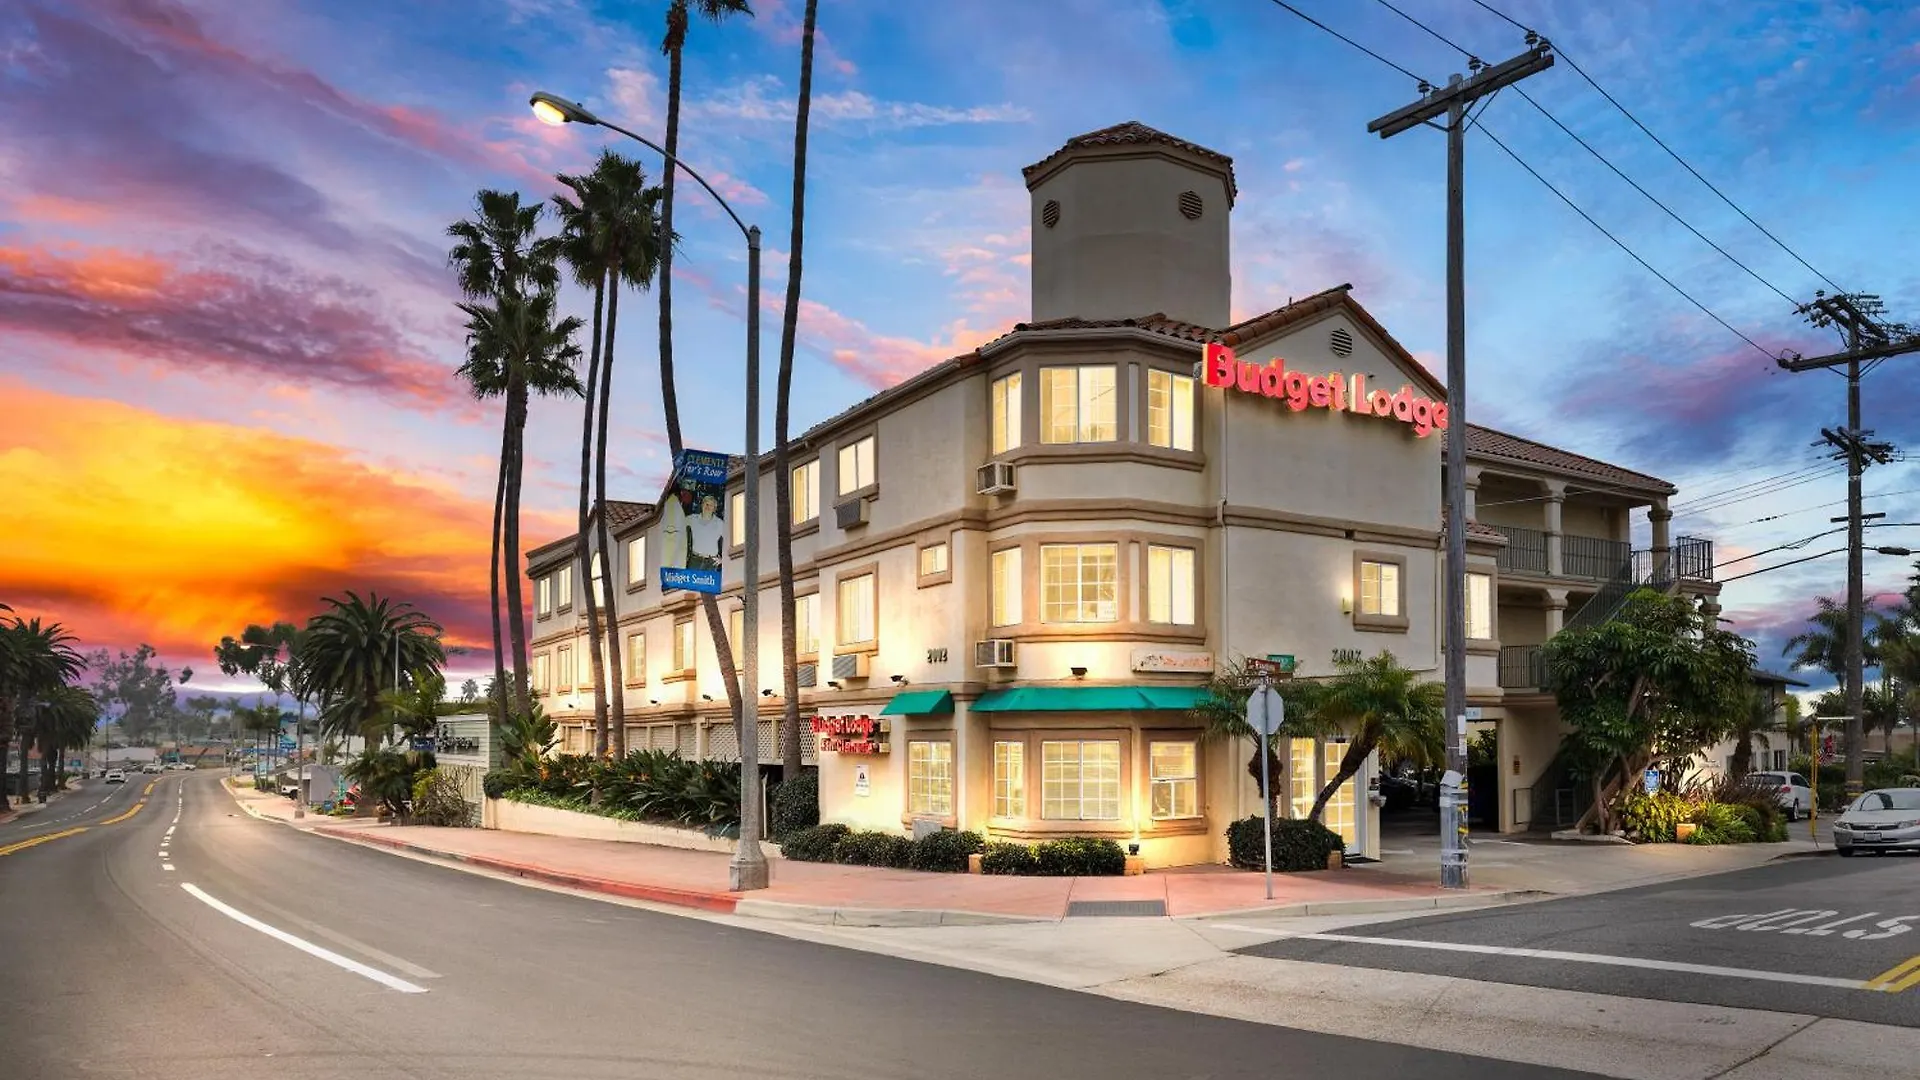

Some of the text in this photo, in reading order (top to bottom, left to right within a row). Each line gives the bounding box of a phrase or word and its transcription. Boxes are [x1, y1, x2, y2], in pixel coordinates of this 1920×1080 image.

[1202, 342, 1448, 439] Budget Lodge
[691, 573, 715, 586] Smith
[1689, 908, 1920, 940] STOP
